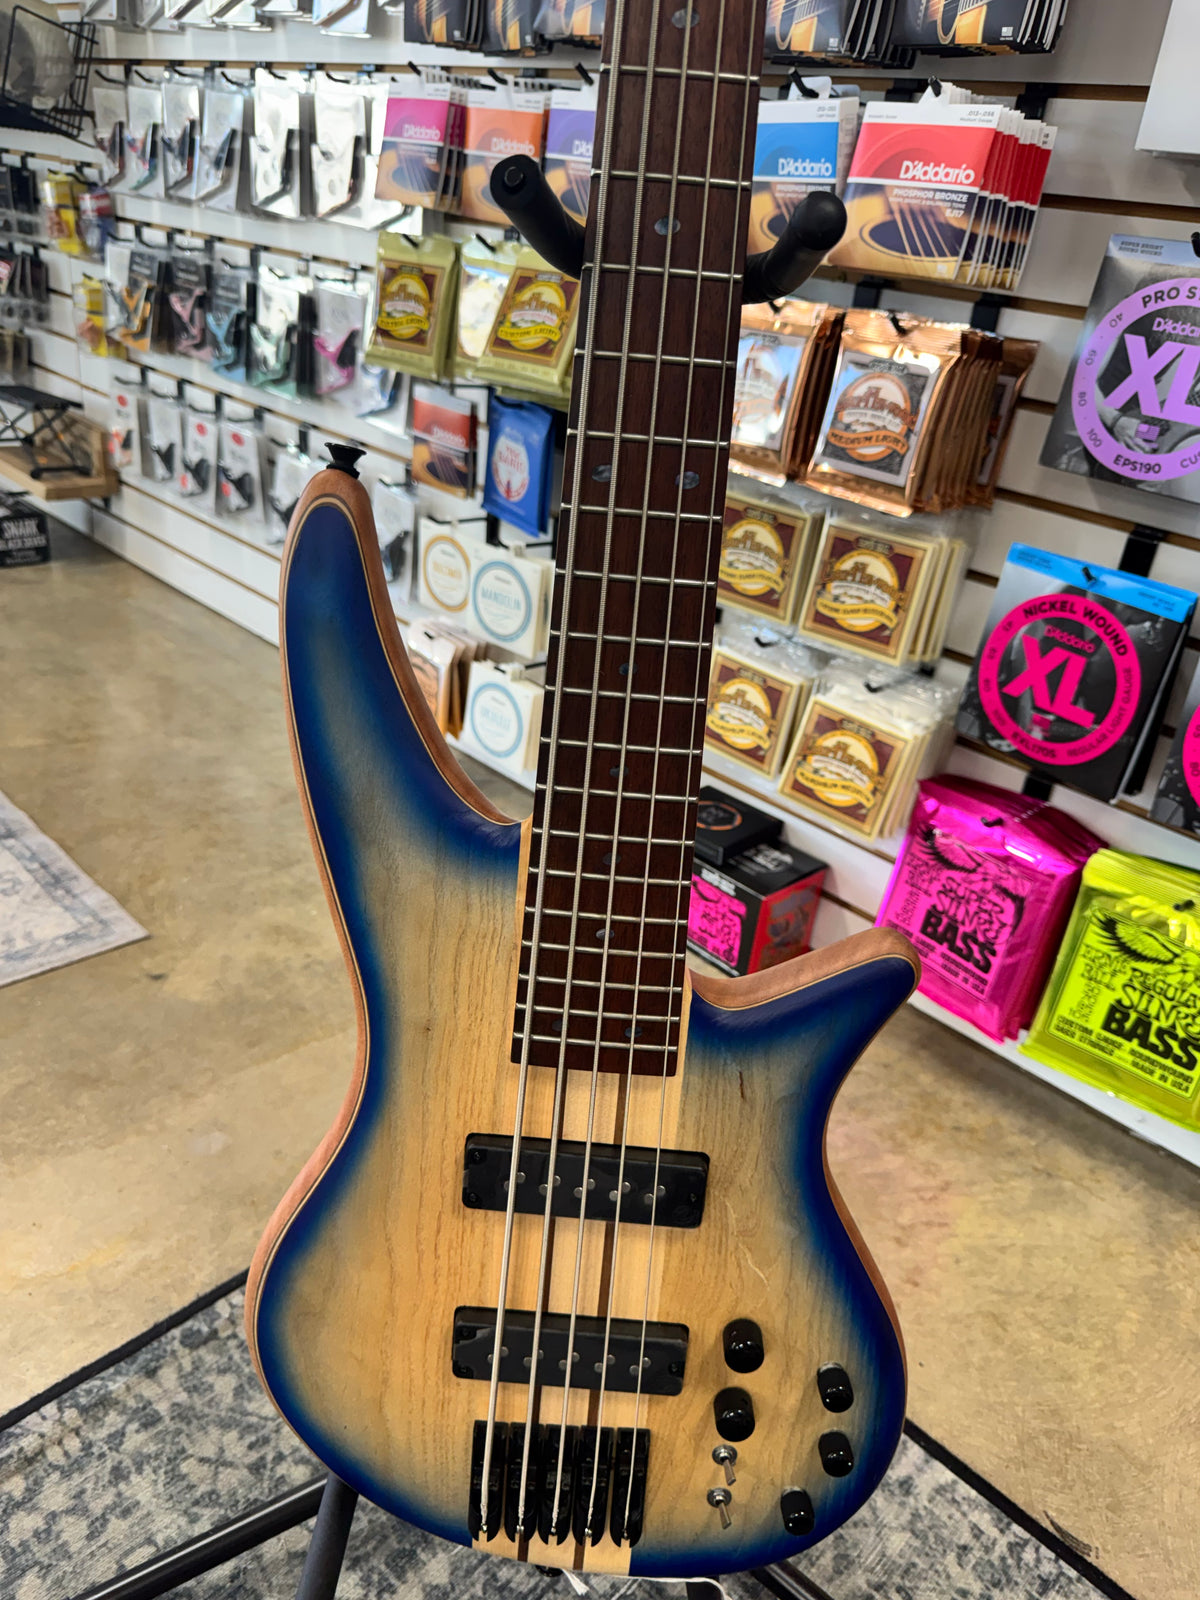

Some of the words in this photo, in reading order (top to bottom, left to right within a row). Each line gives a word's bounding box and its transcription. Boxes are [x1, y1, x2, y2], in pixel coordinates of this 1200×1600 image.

[778, 157, 832, 177] D'Addario
[899, 160, 976, 185] D'Addario
[892, 188, 934, 199] PHOSPHOR
[934, 191, 969, 203] BRONZE
[1142, 286, 1180, 308] PRO
[1186, 286, 1200, 301] S
[1102, 333, 1200, 428] XL
[831, 431, 874, 443] MEDIUM
[1113, 454, 1162, 474] EPS190
[2, 517, 40, 539] SNARK
[1023, 600, 1077, 619] NICKEL
[1083, 606, 1128, 656] WOUND
[1043, 623, 1096, 654] D'Addario
[1001, 633, 1097, 730] XL
[1121, 666, 1133, 705] GAUGE
[943, 875, 1005, 914] SUPER
[933, 889, 1009, 946] SLINKY
[920, 908, 998, 975] BASS
[1129, 967, 1200, 1010] REGULA
[1058, 1014, 1094, 1037] CUSTOM
[1095, 1031, 1124, 1050] GAUGE
[1128, 1047, 1195, 1085] ROUNDWOUND
[1101, 1003, 1199, 1072] BASS
[1130, 1059, 1156, 1078] MADE
[1157, 1072, 1169, 1084] IN
[1170, 1078, 1191, 1094] USA
